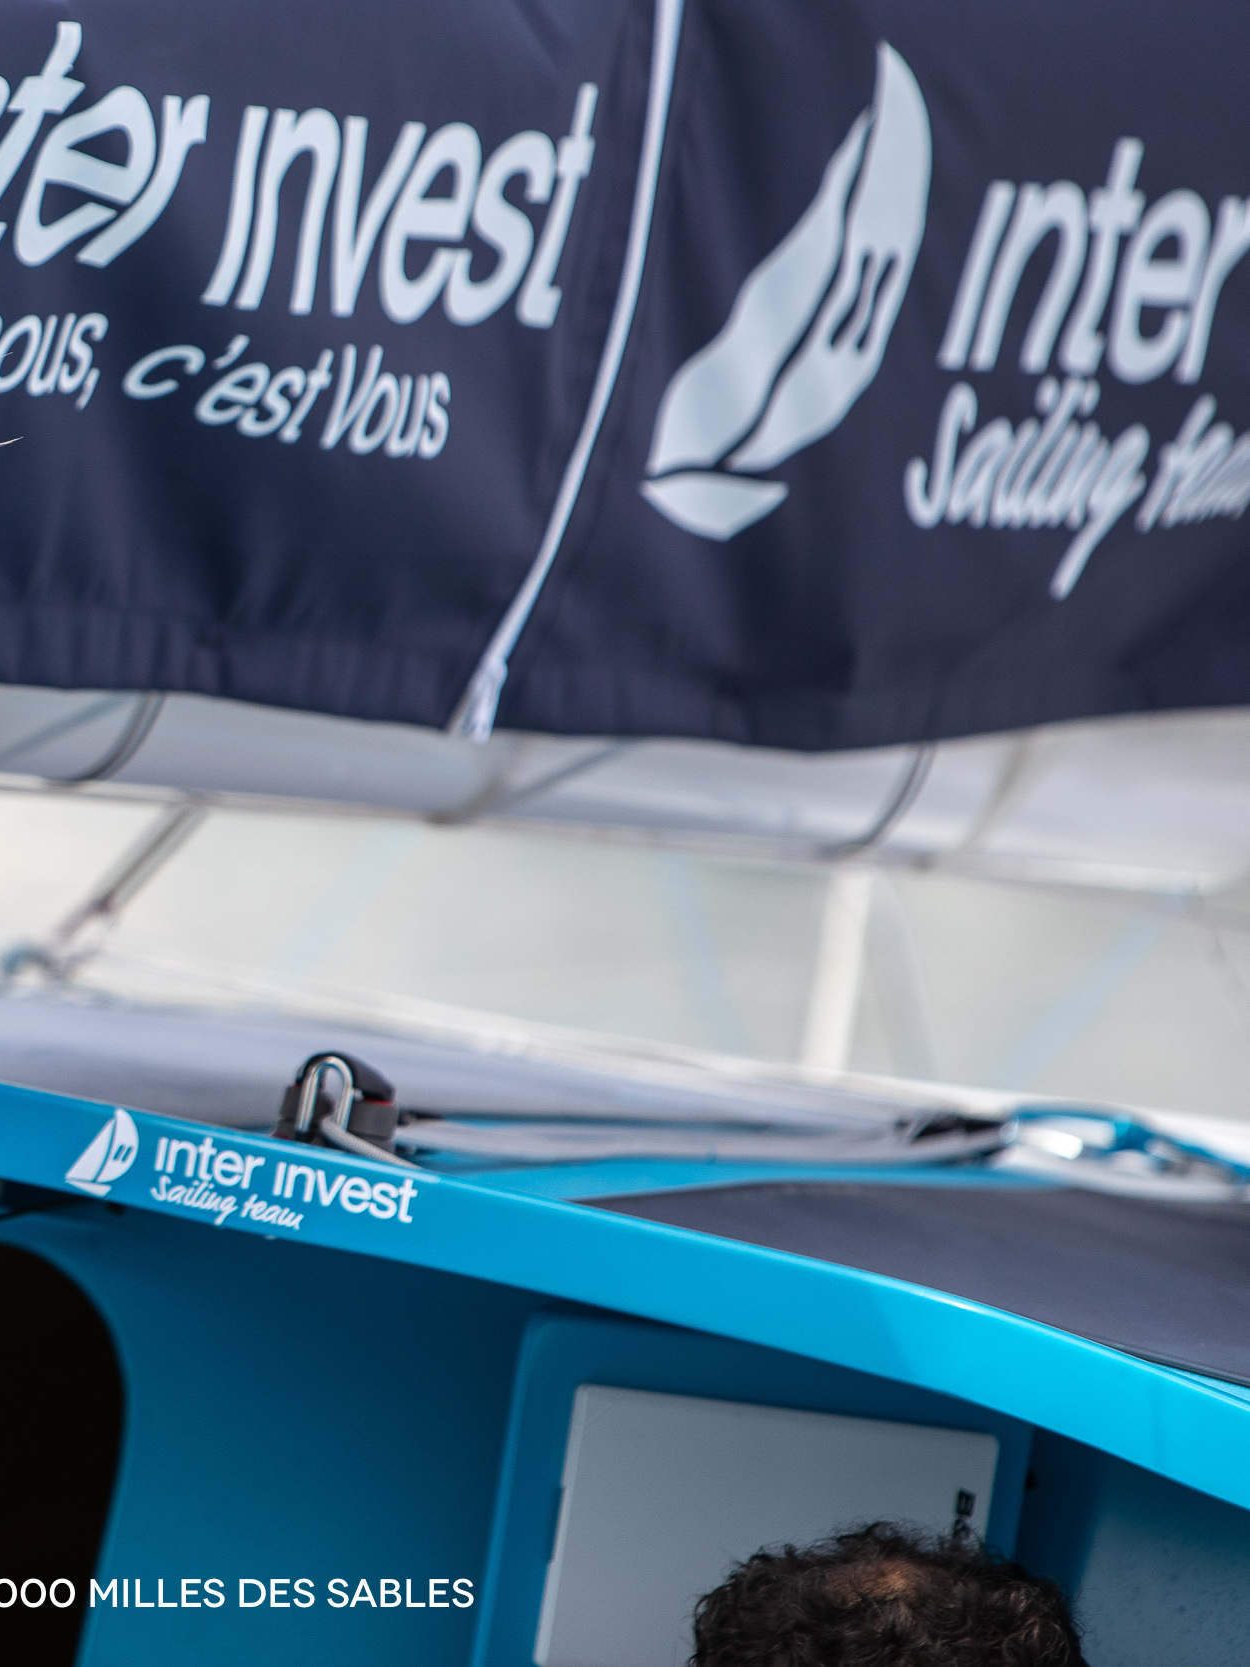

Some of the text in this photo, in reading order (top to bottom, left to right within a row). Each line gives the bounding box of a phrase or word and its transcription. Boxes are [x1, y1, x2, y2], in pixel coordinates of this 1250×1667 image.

[200, 82, 599, 328] invest
[122, 334, 334, 443] c'est
[320, 344, 450, 459] Vous
[151, 1176, 305, 1230] Sailing team
[154, 1137, 418, 1224] inter invest
